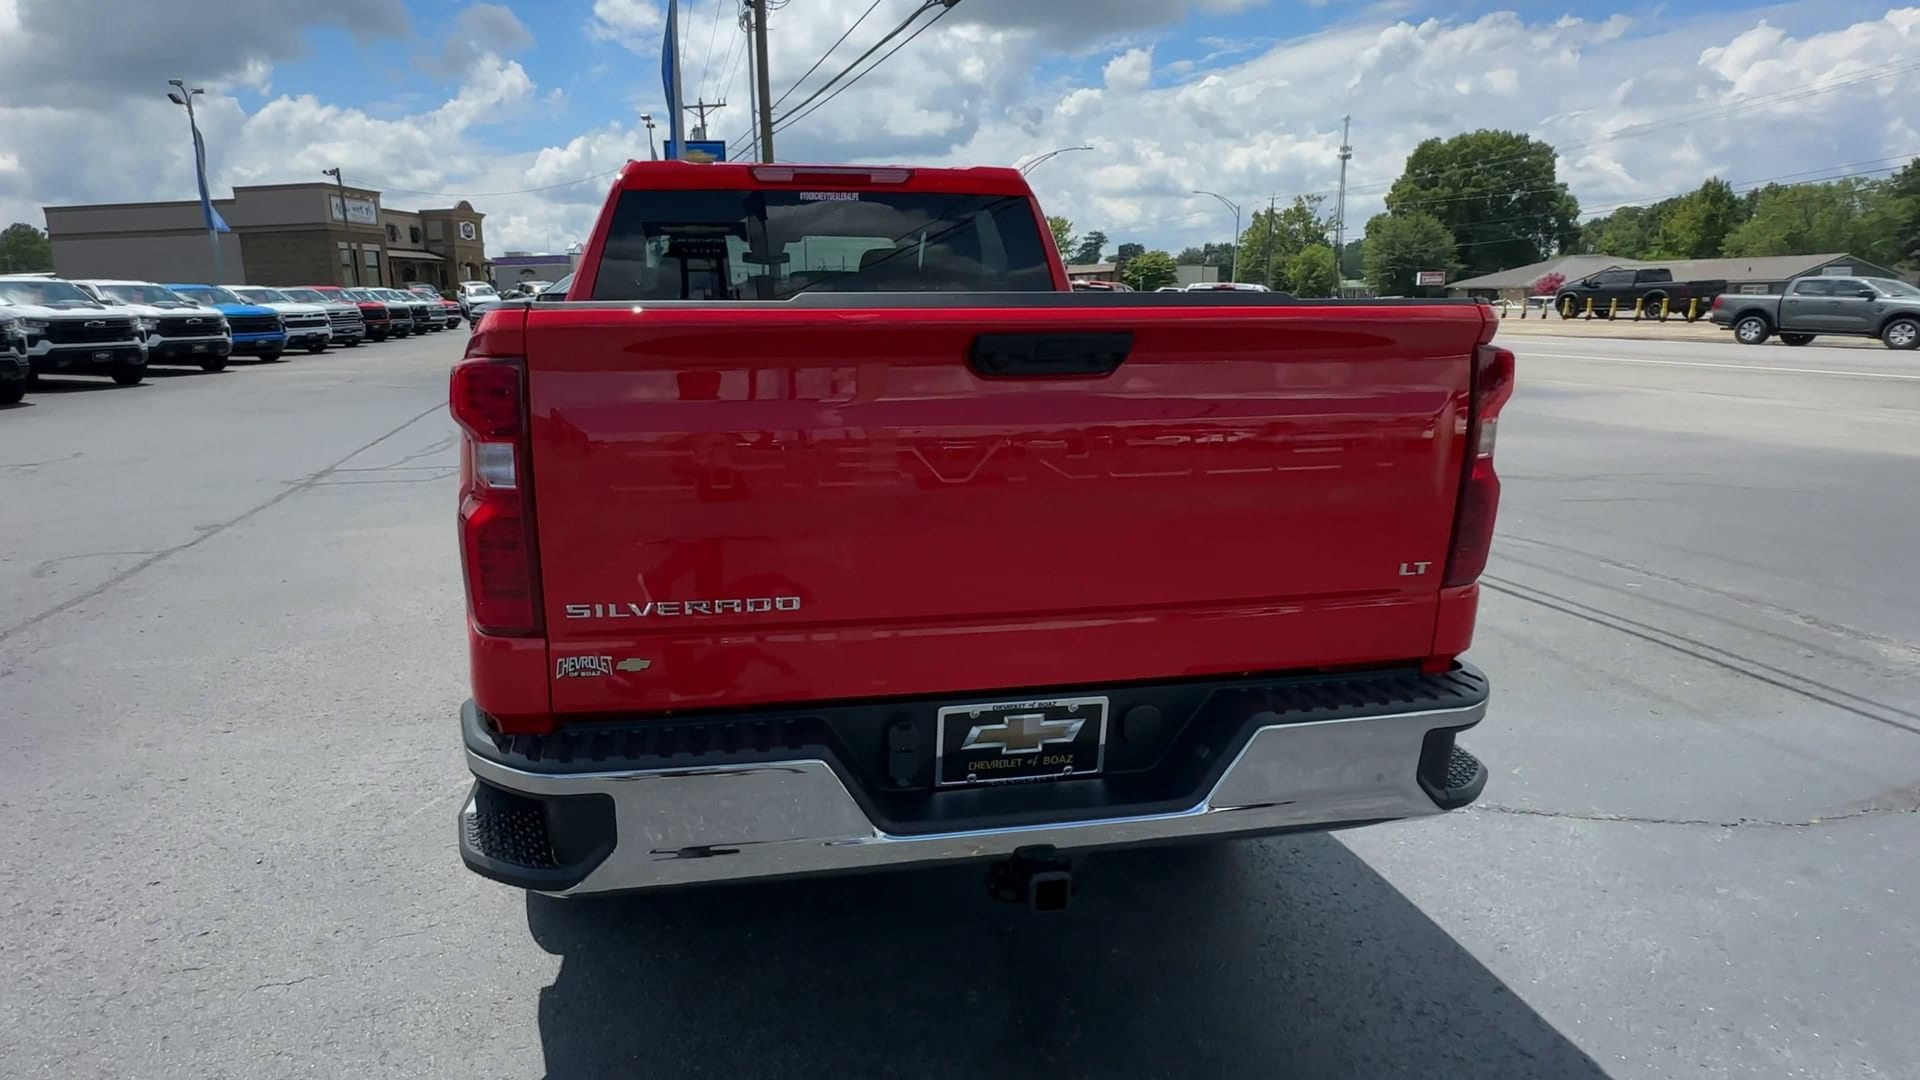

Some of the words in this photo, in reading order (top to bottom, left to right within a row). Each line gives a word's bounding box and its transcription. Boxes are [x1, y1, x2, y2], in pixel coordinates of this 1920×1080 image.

[1399, 561, 1432, 576] LT
[566, 596, 801, 619] SILVERADO
[556, 656, 613, 679] CHEVROLET
[992, 702, 1026, 711] CHEVROLET
[968, 758, 1023, 771] CHEVROLET
[1027, 756, 1039, 767] of
[1043, 754, 1074, 765] BOAZ
